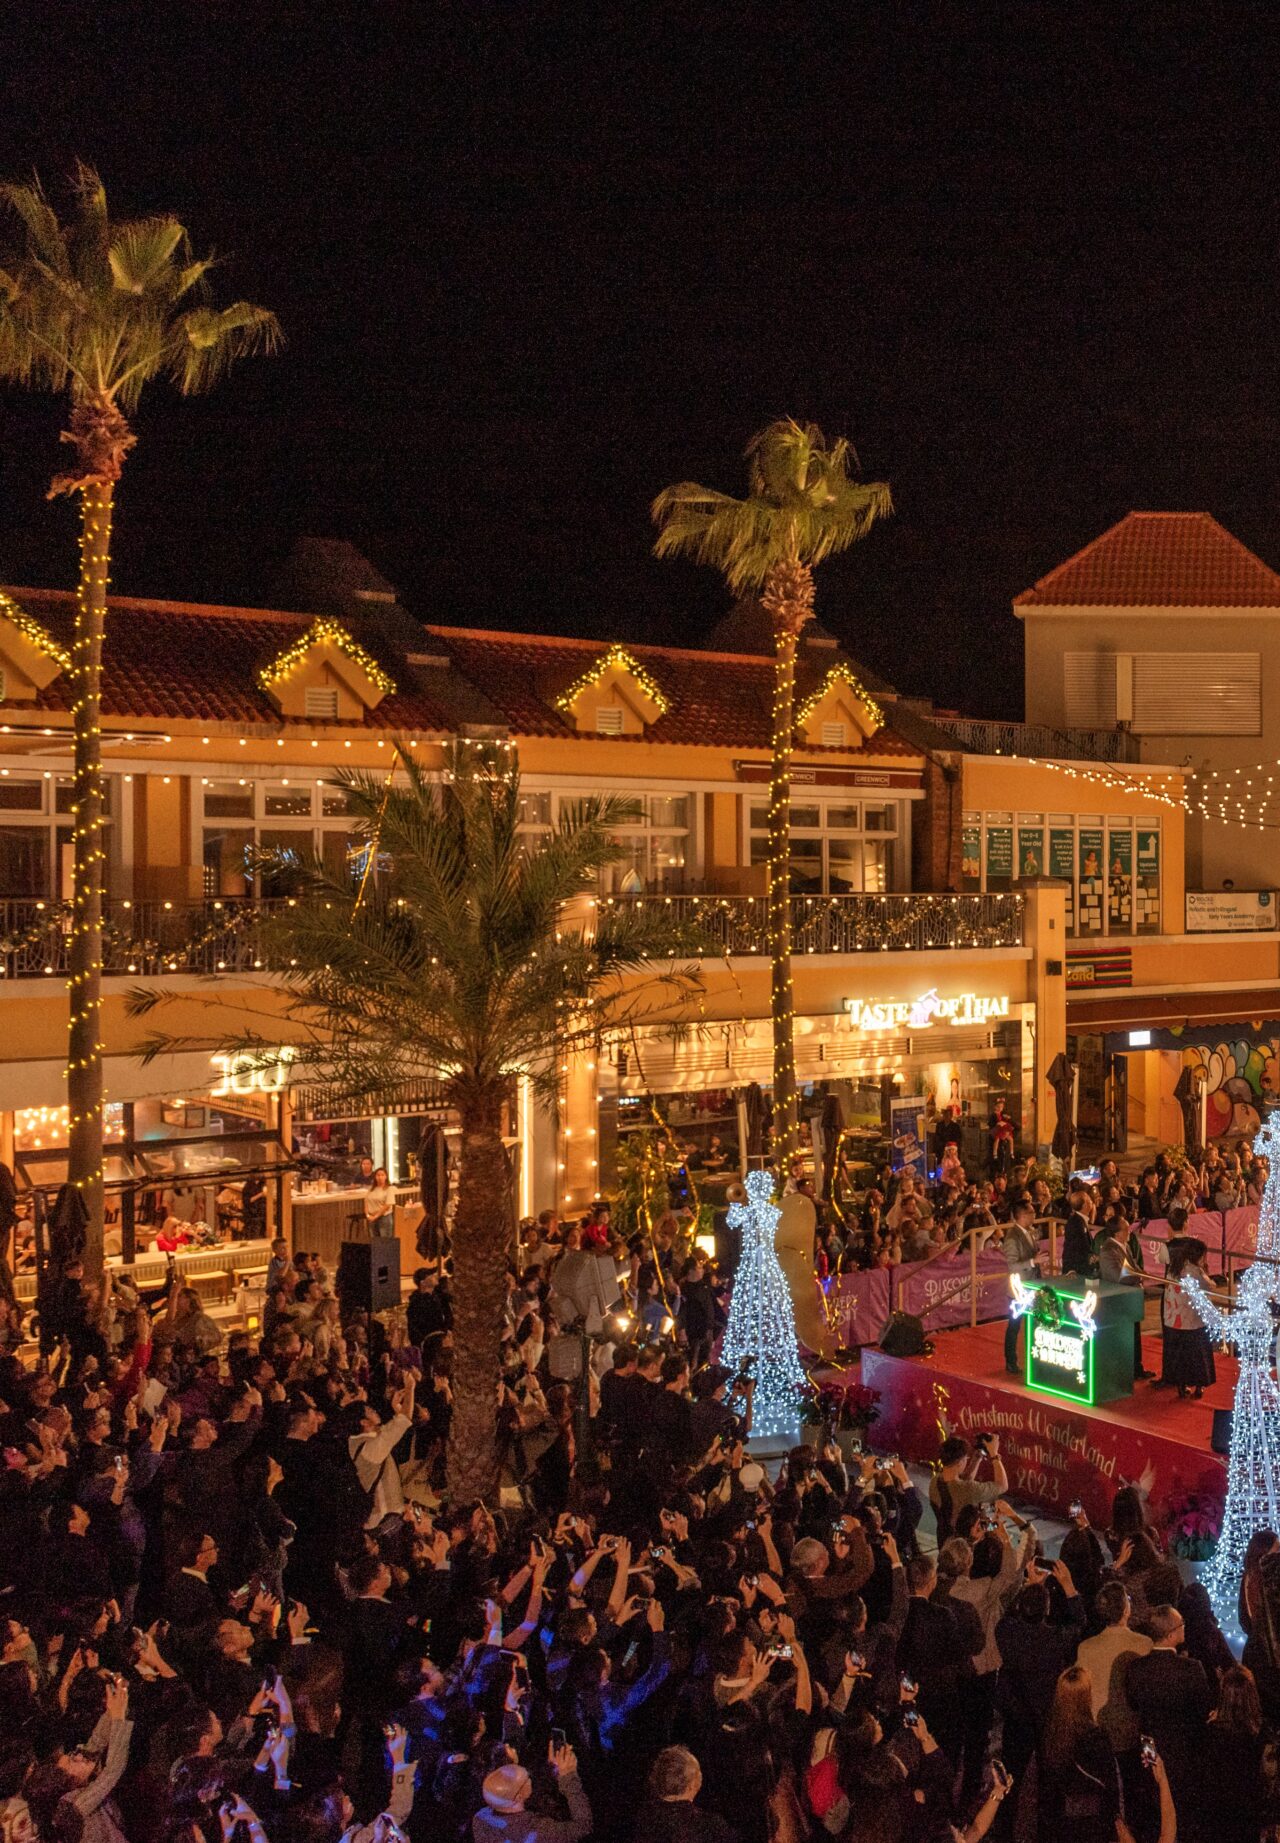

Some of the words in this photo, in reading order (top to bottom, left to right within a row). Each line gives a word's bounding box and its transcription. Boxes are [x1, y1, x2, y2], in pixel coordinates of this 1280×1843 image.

[856, 775, 889, 783] GREENWICH
[845, 999, 909, 1025] TASTE
[934, 998, 960, 1017] OF
[960, 993, 1009, 1017] THAI
[960, 1404, 1024, 1430] Christmas
[1034, 1445, 1069, 1472] Natale
[1016, 1467, 1060, 1502] 2023
